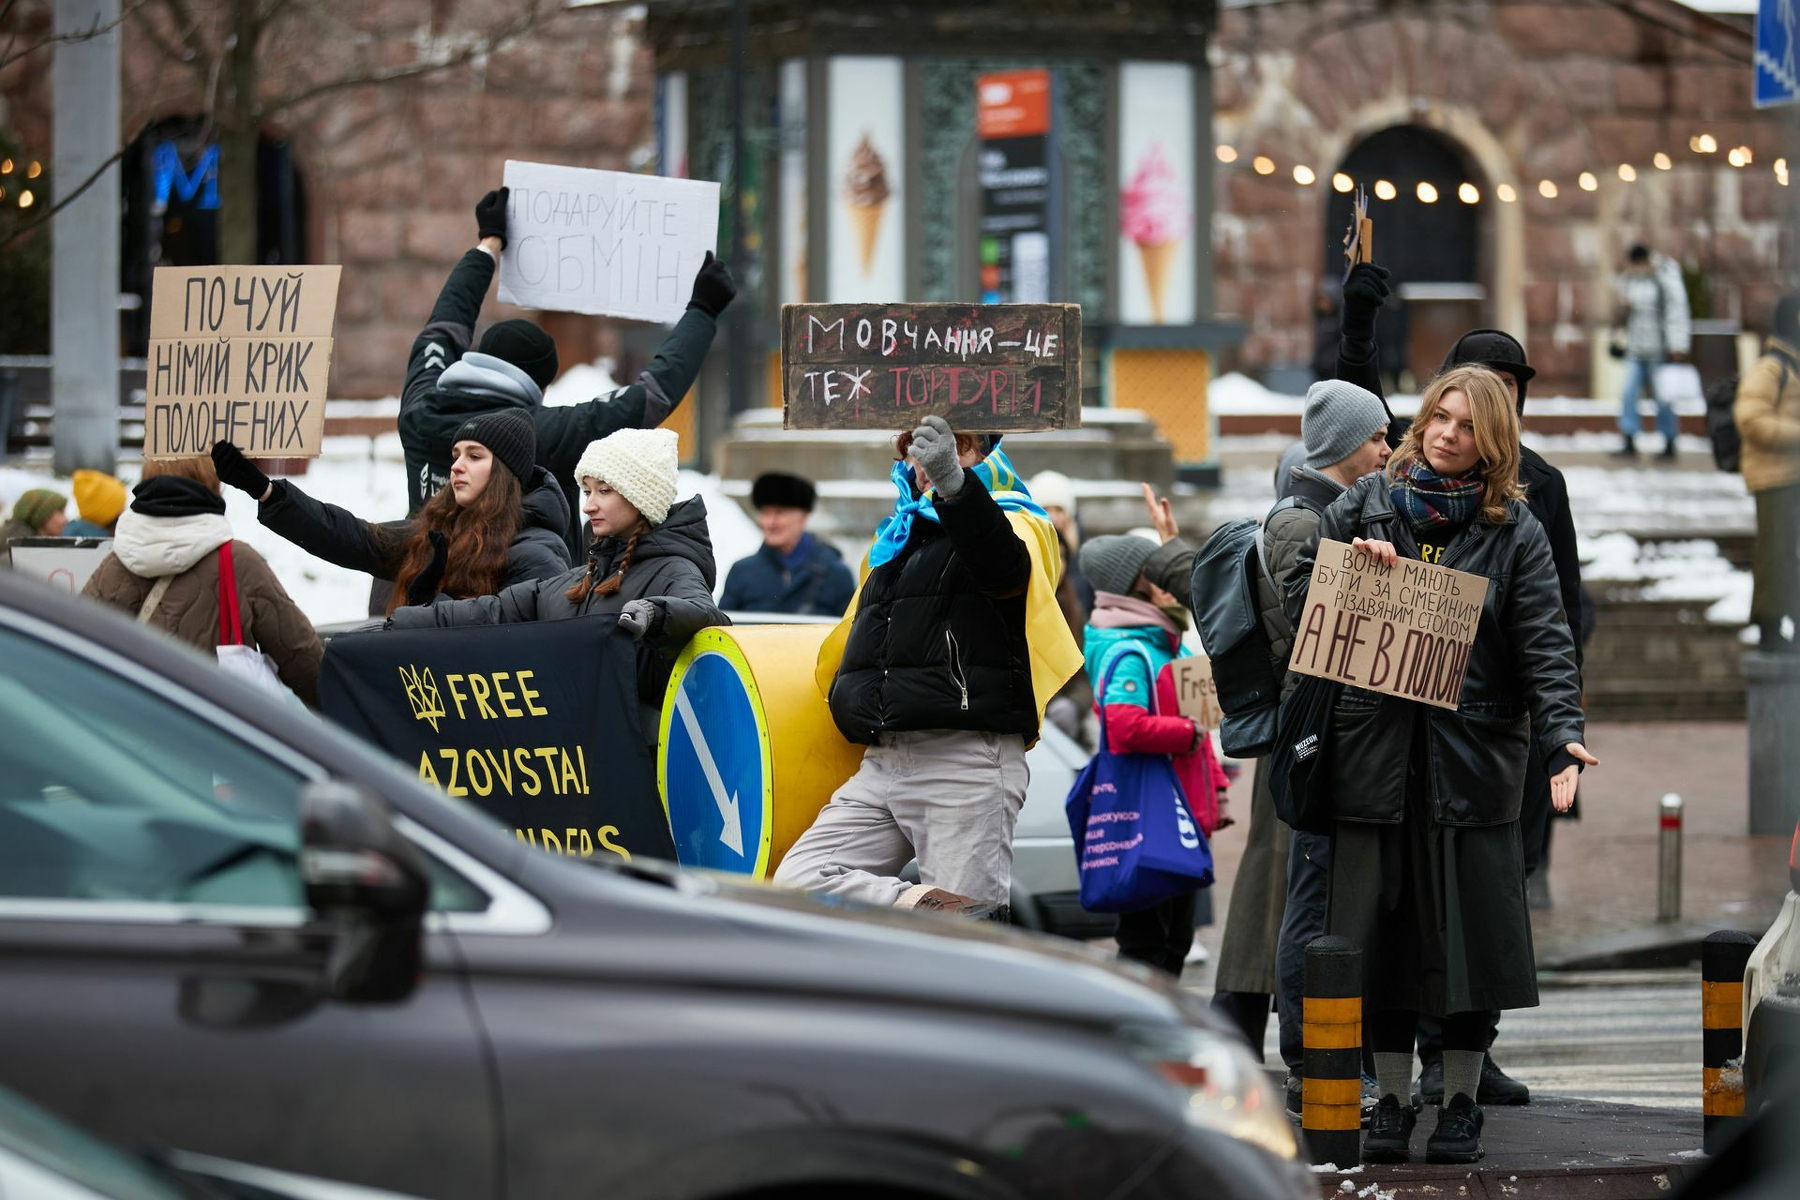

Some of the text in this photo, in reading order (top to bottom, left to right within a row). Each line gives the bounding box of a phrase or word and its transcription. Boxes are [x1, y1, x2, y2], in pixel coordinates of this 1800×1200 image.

[513, 187, 678, 237] ПОДАРУЙТЕ
[516, 231, 681, 304] ОБМІН
[184, 272, 304, 332] ПОЧУЙ
[155, 336, 314, 397] НІМИЙ КРИК
[1023, 328, 1059, 358] ЦЕ
[804, 366, 1042, 415] ТЕЖ ТОРТУРИ
[153, 400, 310, 454] ПОЛОНЕНИХ
[1317, 564, 1480, 624] БУТИ ЗА СІМЕЙНИМ
[1342, 548, 1461, 596] ВОНИ МАЮТЬ
[1334, 590, 1414, 626] РІЗДВЯНИМ
[1295, 603, 1326, 669] А
[1325, 611, 1371, 681] НЕ
[1368, 621, 1395, 687] В
[446, 670, 549, 720] FREE
[1180, 666, 1217, 701] Free
